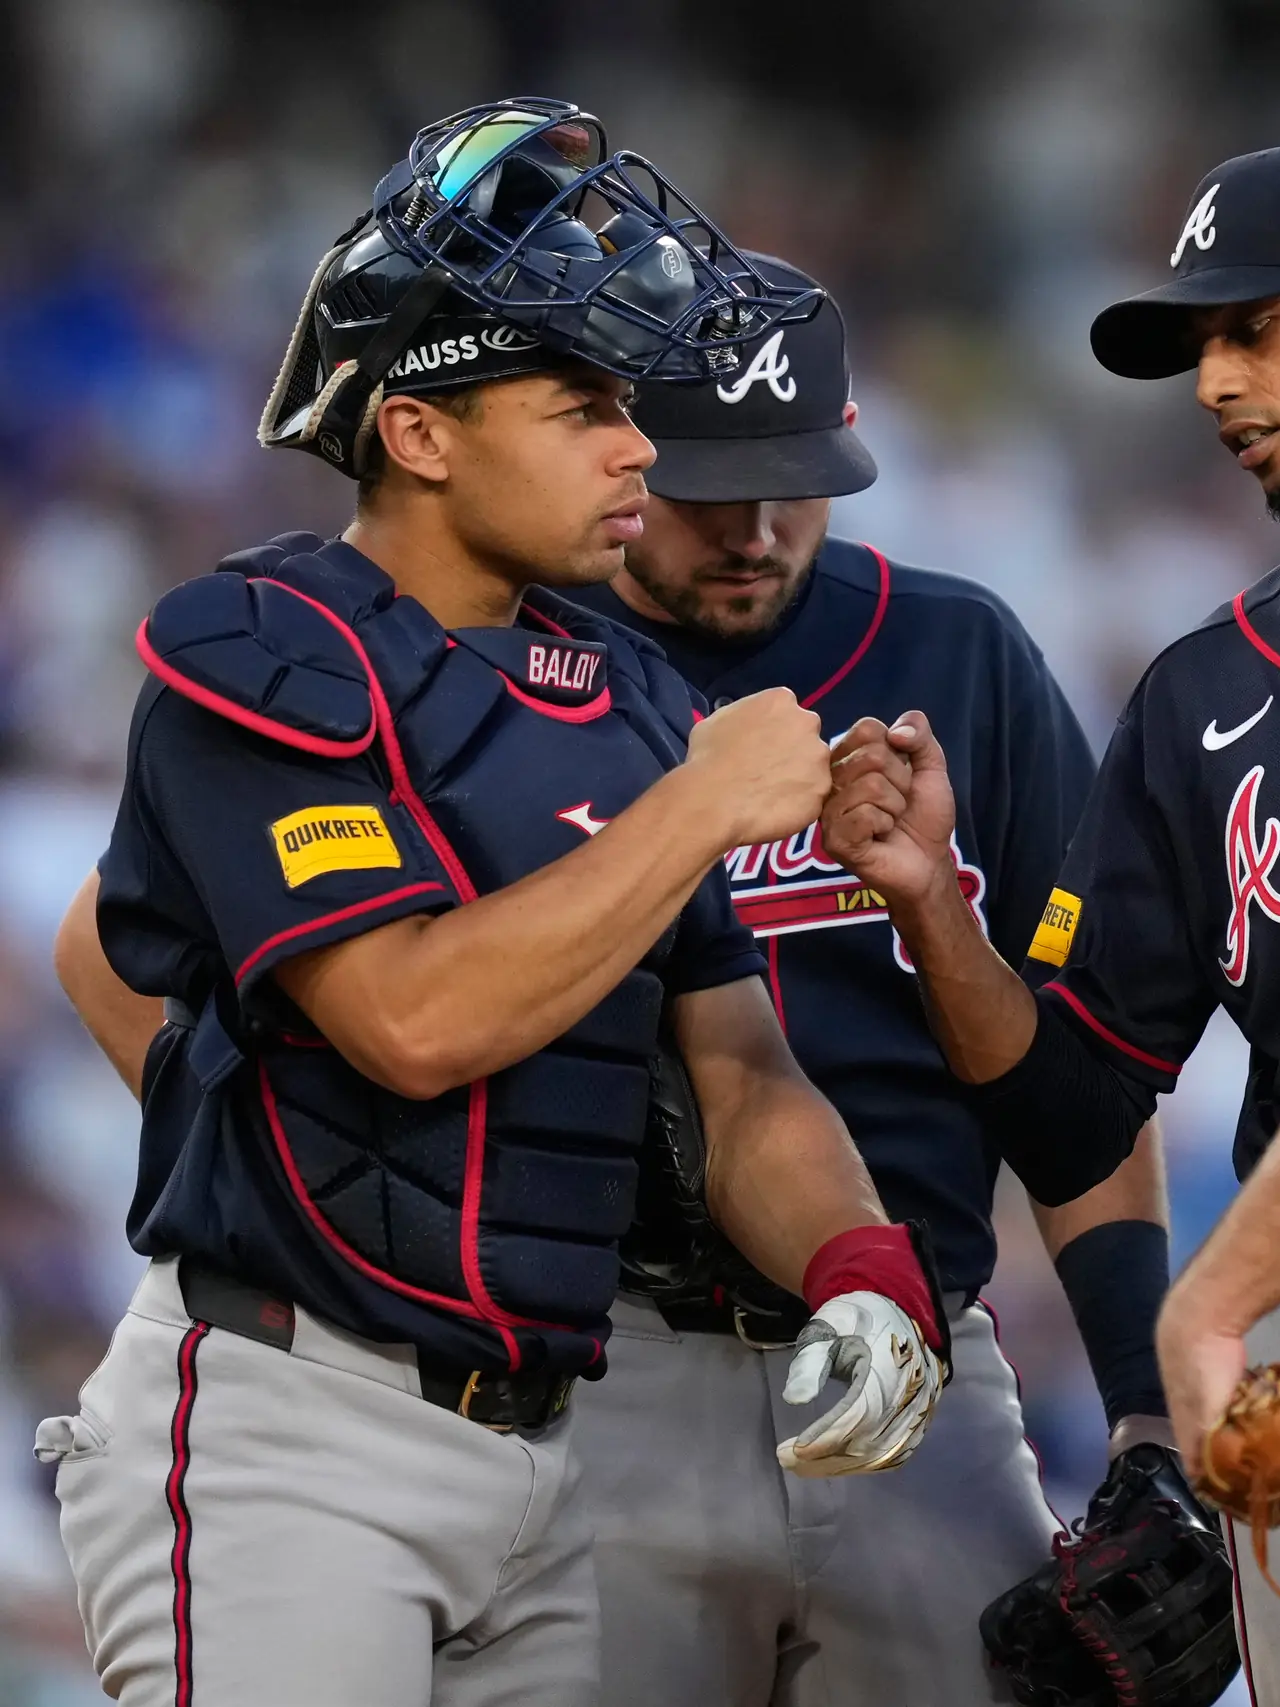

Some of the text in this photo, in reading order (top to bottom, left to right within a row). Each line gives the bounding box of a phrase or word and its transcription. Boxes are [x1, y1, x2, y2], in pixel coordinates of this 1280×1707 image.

[1170, 183, 1221, 269] A
[716, 329, 797, 405] A
[528, 644, 601, 692] BALDY
[282, 819, 385, 854] QUIKRETE
